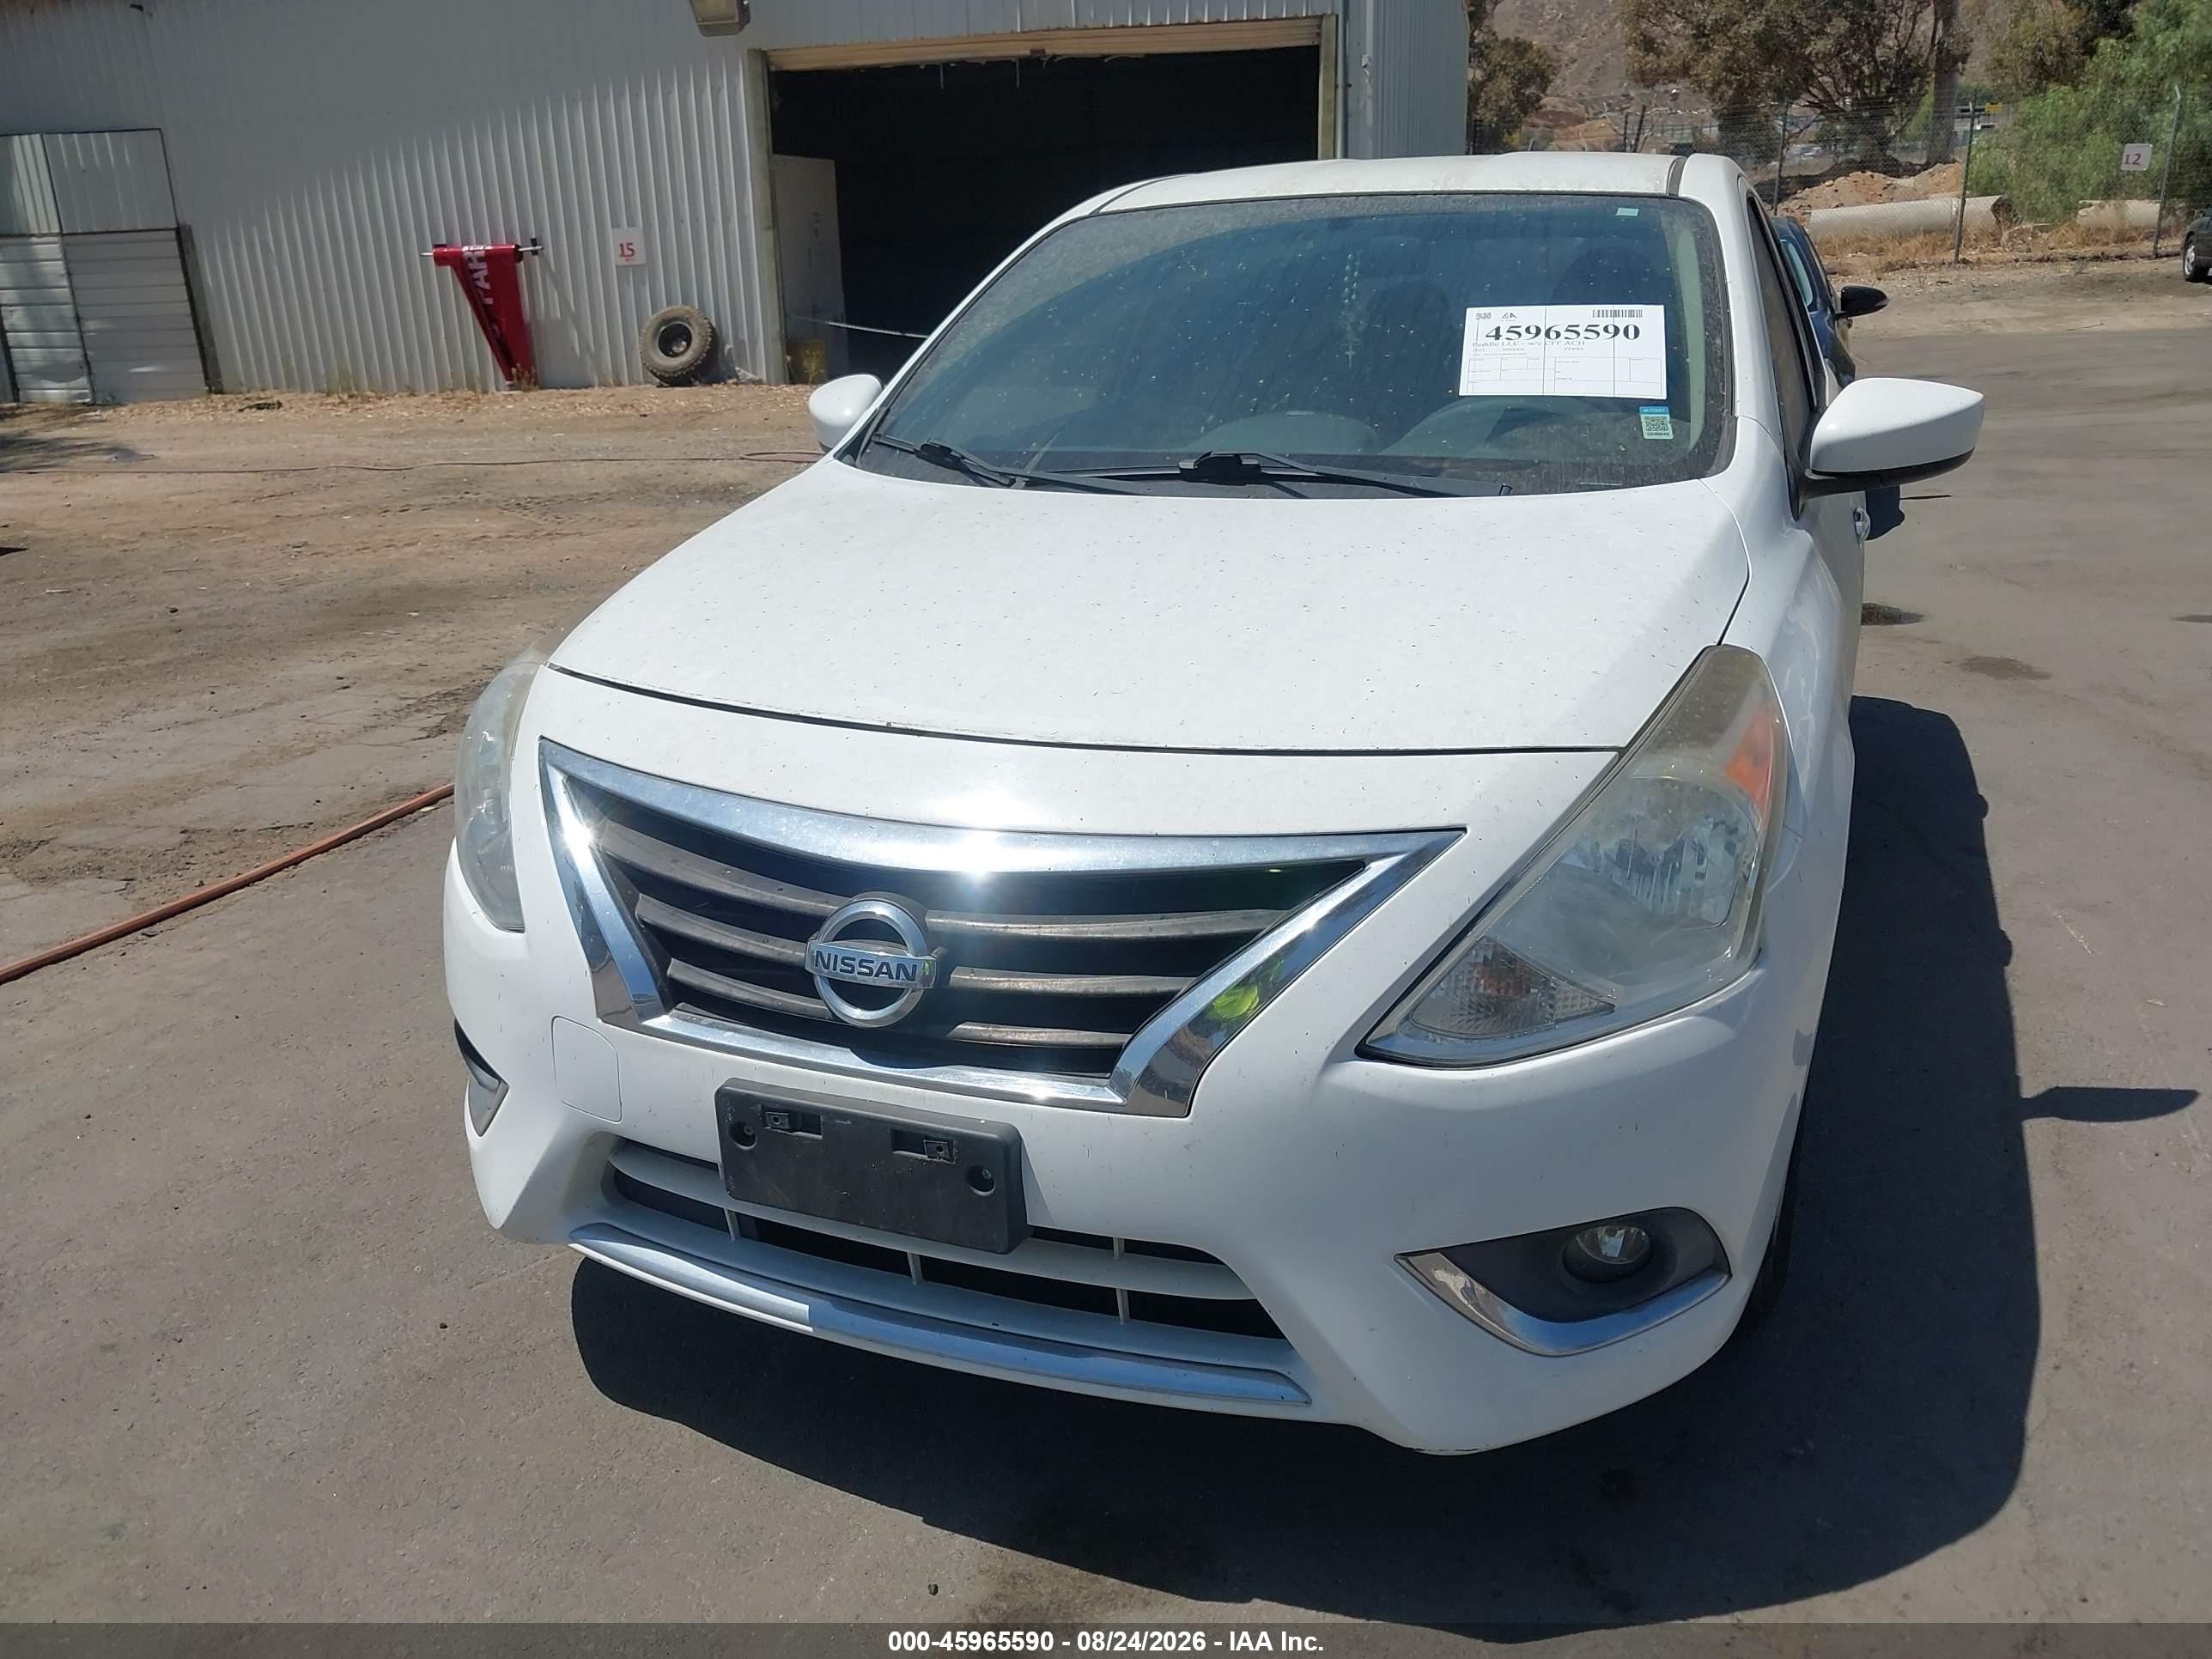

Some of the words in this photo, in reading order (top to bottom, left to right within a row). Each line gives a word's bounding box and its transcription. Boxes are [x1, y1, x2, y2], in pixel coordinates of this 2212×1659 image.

[2124, 153, 2142, 166] 12
[619, 242, 635, 258] 15
[1485, 324, 1641, 341] 45965590
[814, 950, 918, 981] NISSAN
